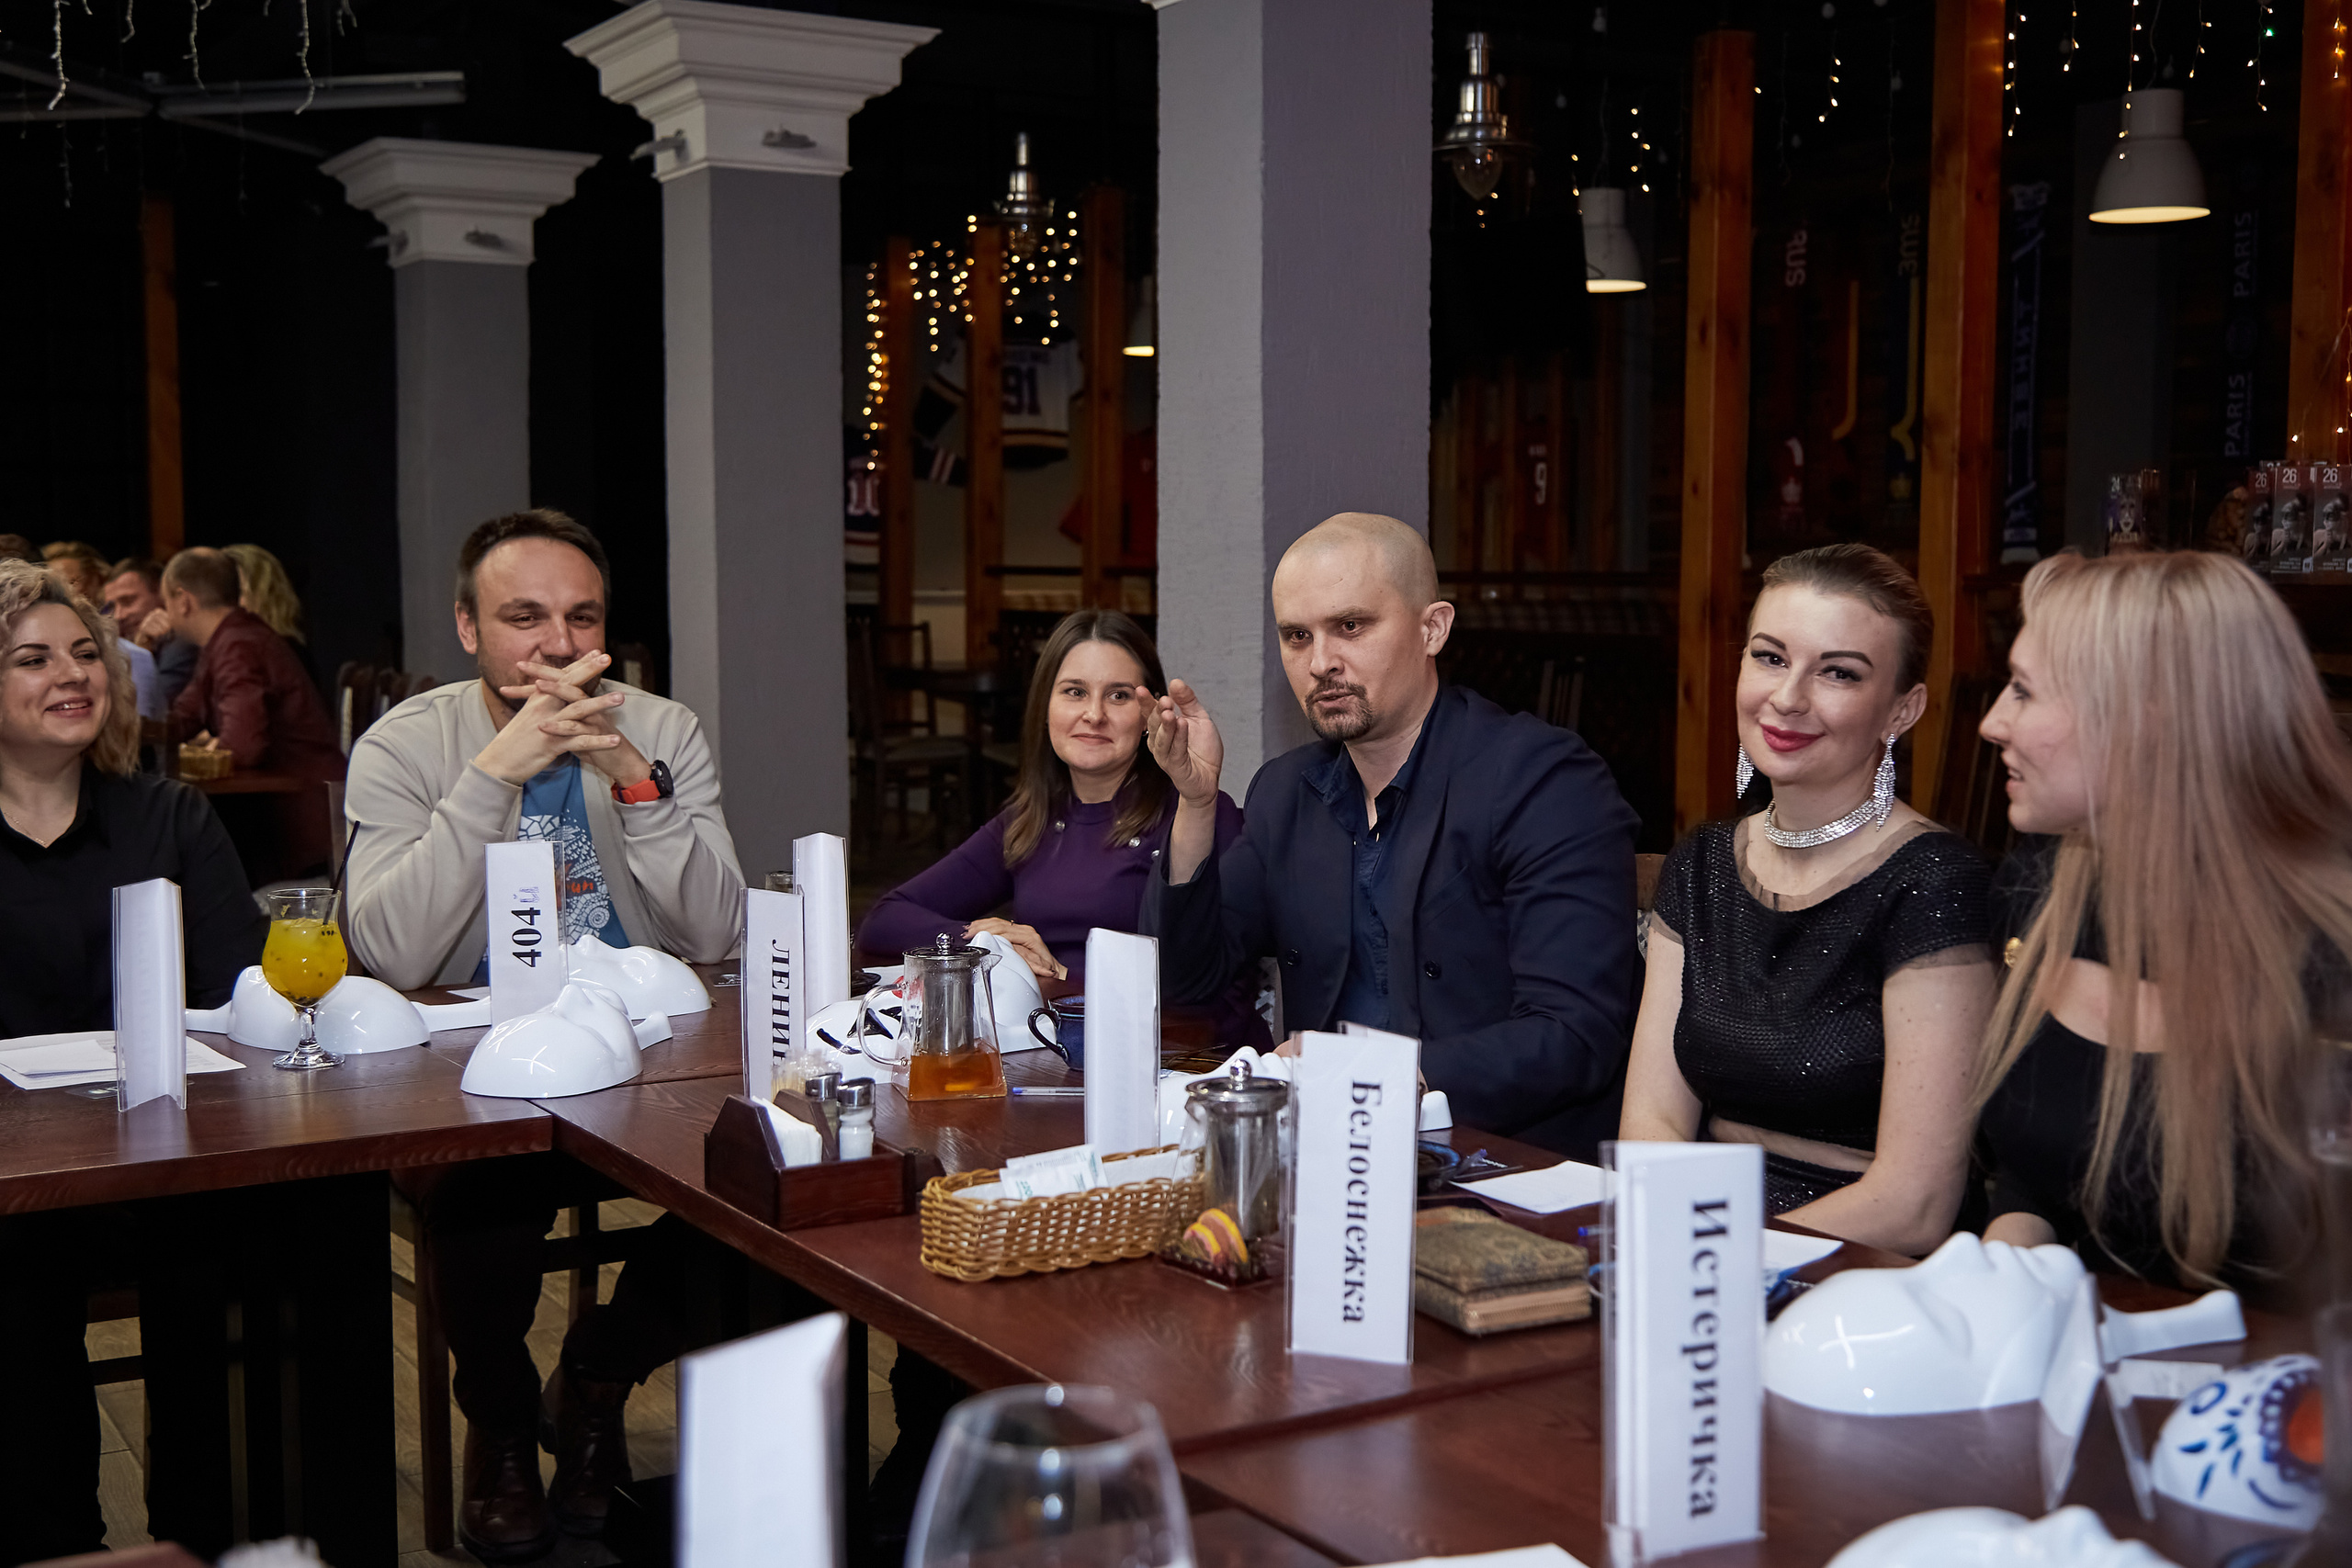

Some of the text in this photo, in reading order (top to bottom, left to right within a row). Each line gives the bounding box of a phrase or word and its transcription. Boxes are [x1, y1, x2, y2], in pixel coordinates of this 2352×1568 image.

[2233, 211, 2253, 298] PARIS
[2224, 374, 2246, 457] PARIS
[2282, 468, 2298, 483] 26
[2323, 468, 2338, 483] 26
[1341, 1078, 1385, 1325] Белоснежка
[1681, 1199, 1730, 1518] Истеричка
